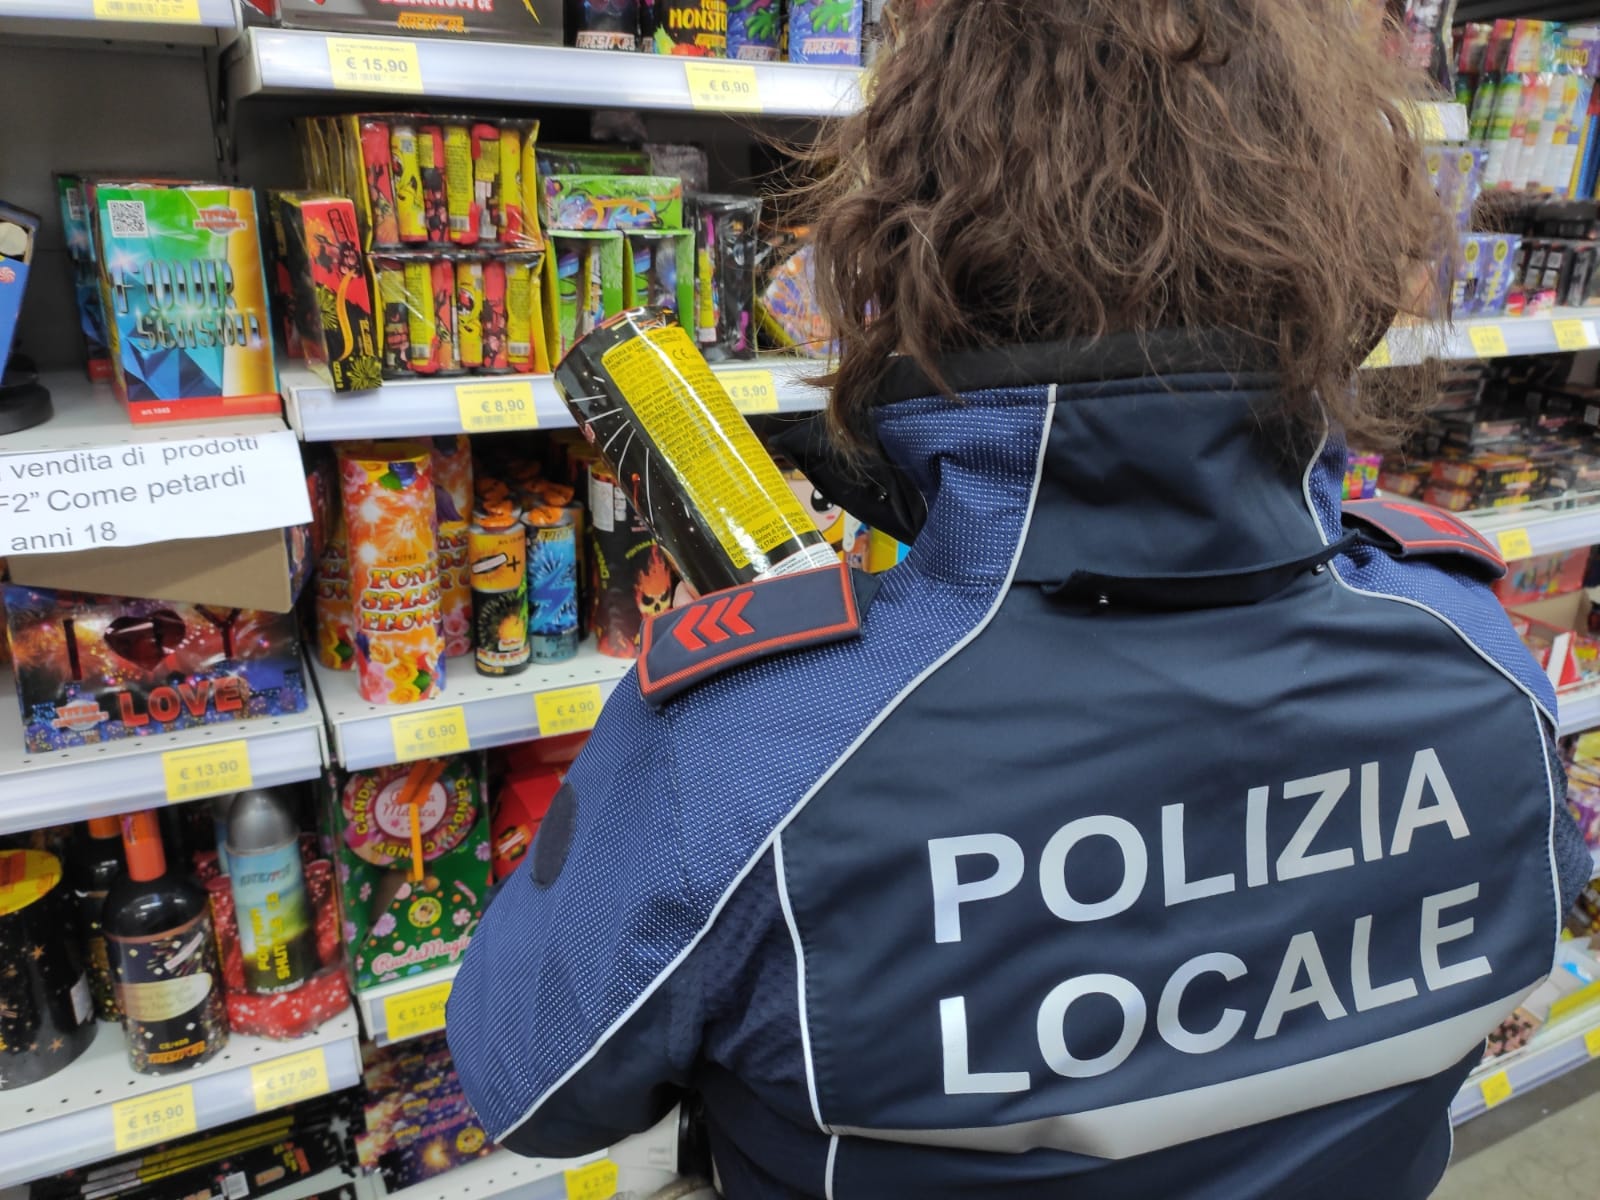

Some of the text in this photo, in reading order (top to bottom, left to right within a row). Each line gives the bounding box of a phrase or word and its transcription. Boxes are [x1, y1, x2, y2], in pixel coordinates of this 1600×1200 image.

[363, 57, 408, 73] 15,90
[721, 80, 750, 94] 6,90
[742, 385, 768, 398] 5,90
[481, 399, 525, 413] € 8,90
[10, 436, 259, 480] vendita di prodotti
[47, 485, 138, 512] Come
[148, 465, 247, 503] petardi
[11, 521, 118, 552] anni 18
[117, 676, 244, 728] LOVE
[568, 701, 594, 714] 4,90
[428, 723, 457, 738] 6,90
[196, 759, 239, 777] 13,90
[353, 779, 376, 835] CANDY
[448, 778, 469, 833] CANDY
[371, 842, 436, 858] CNDY
[927, 747, 1471, 944] POLIZIA
[938, 881, 1493, 1095] LOCALE
[280, 1066, 318, 1086] 17,90
[144, 1103, 185, 1126] 15,90
